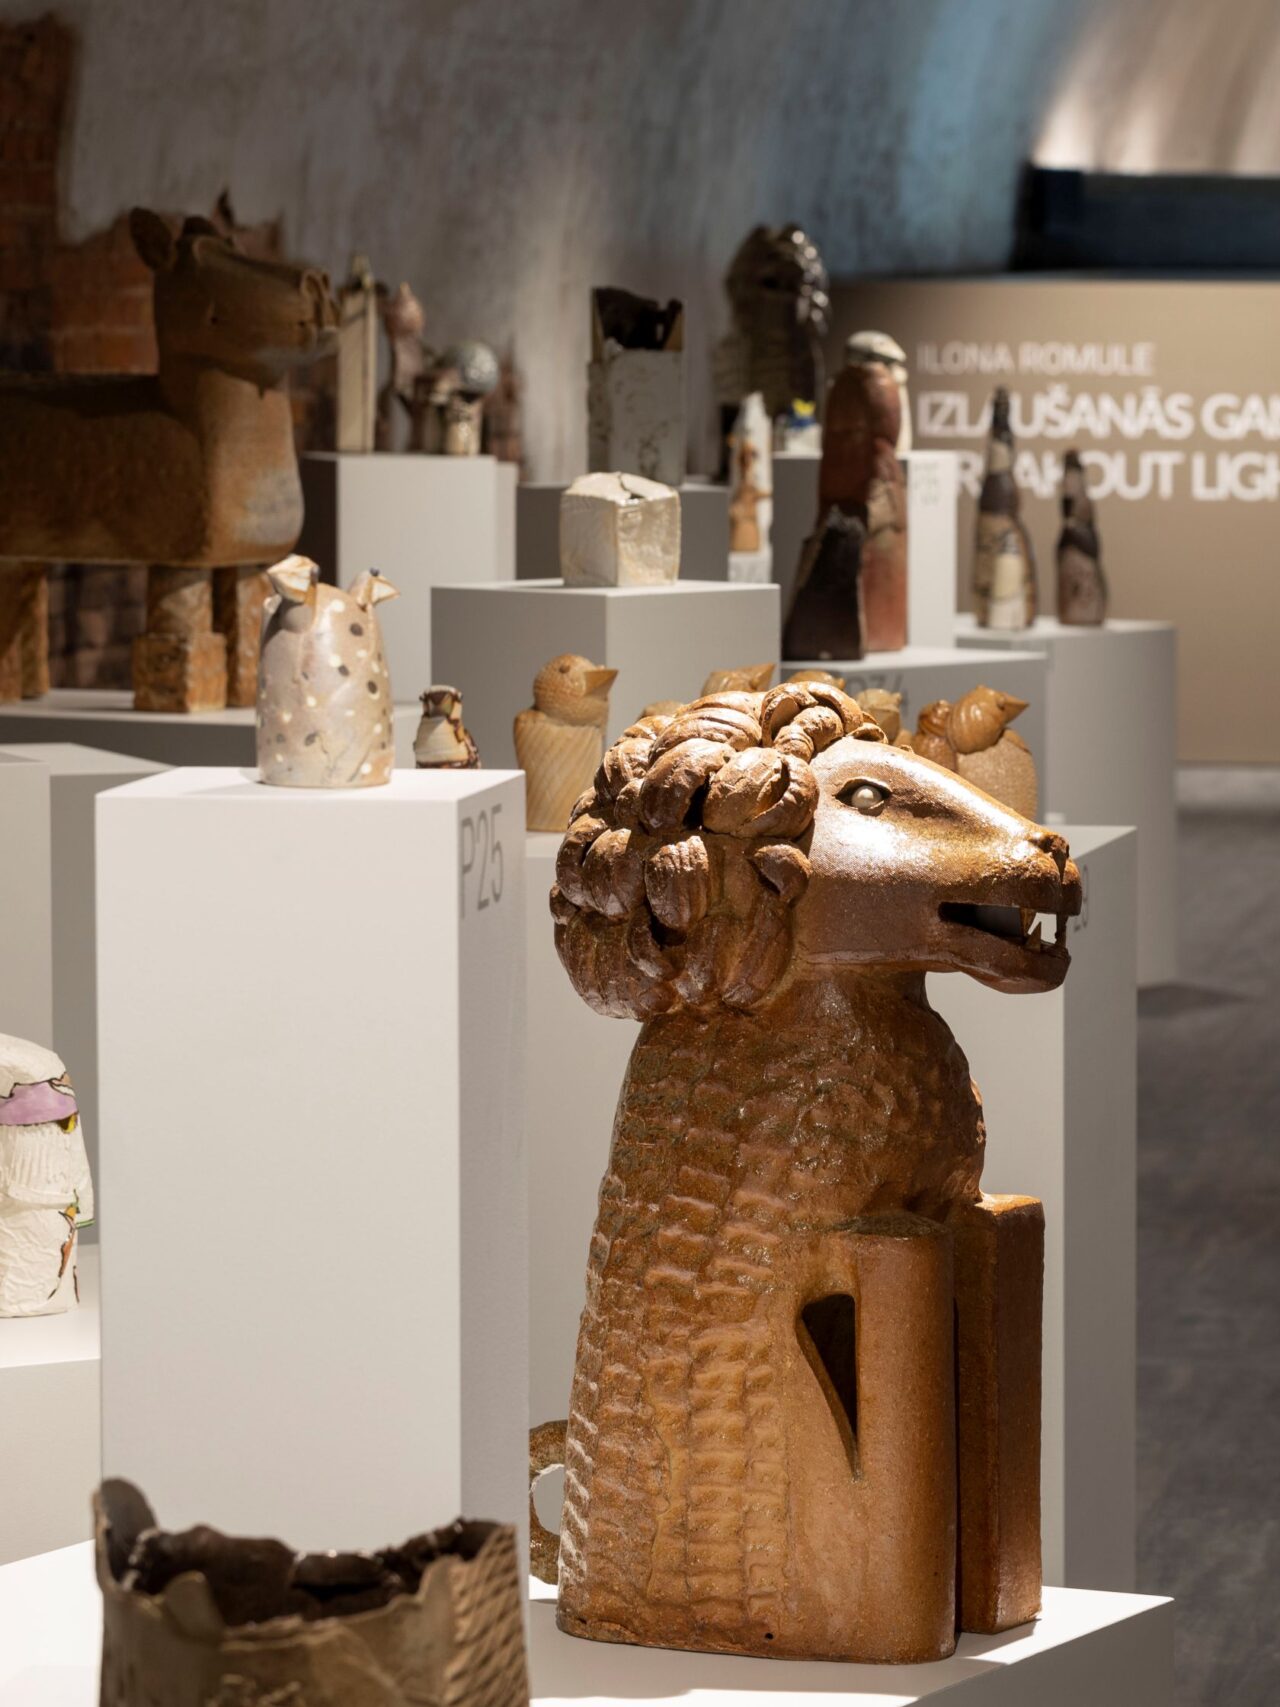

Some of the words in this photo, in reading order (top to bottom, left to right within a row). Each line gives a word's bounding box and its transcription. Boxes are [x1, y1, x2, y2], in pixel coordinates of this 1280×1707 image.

[916, 341, 1015, 375] ILONA
[1018, 341, 1154, 377] ROMULE
[460, 803, 504, 920] P25
